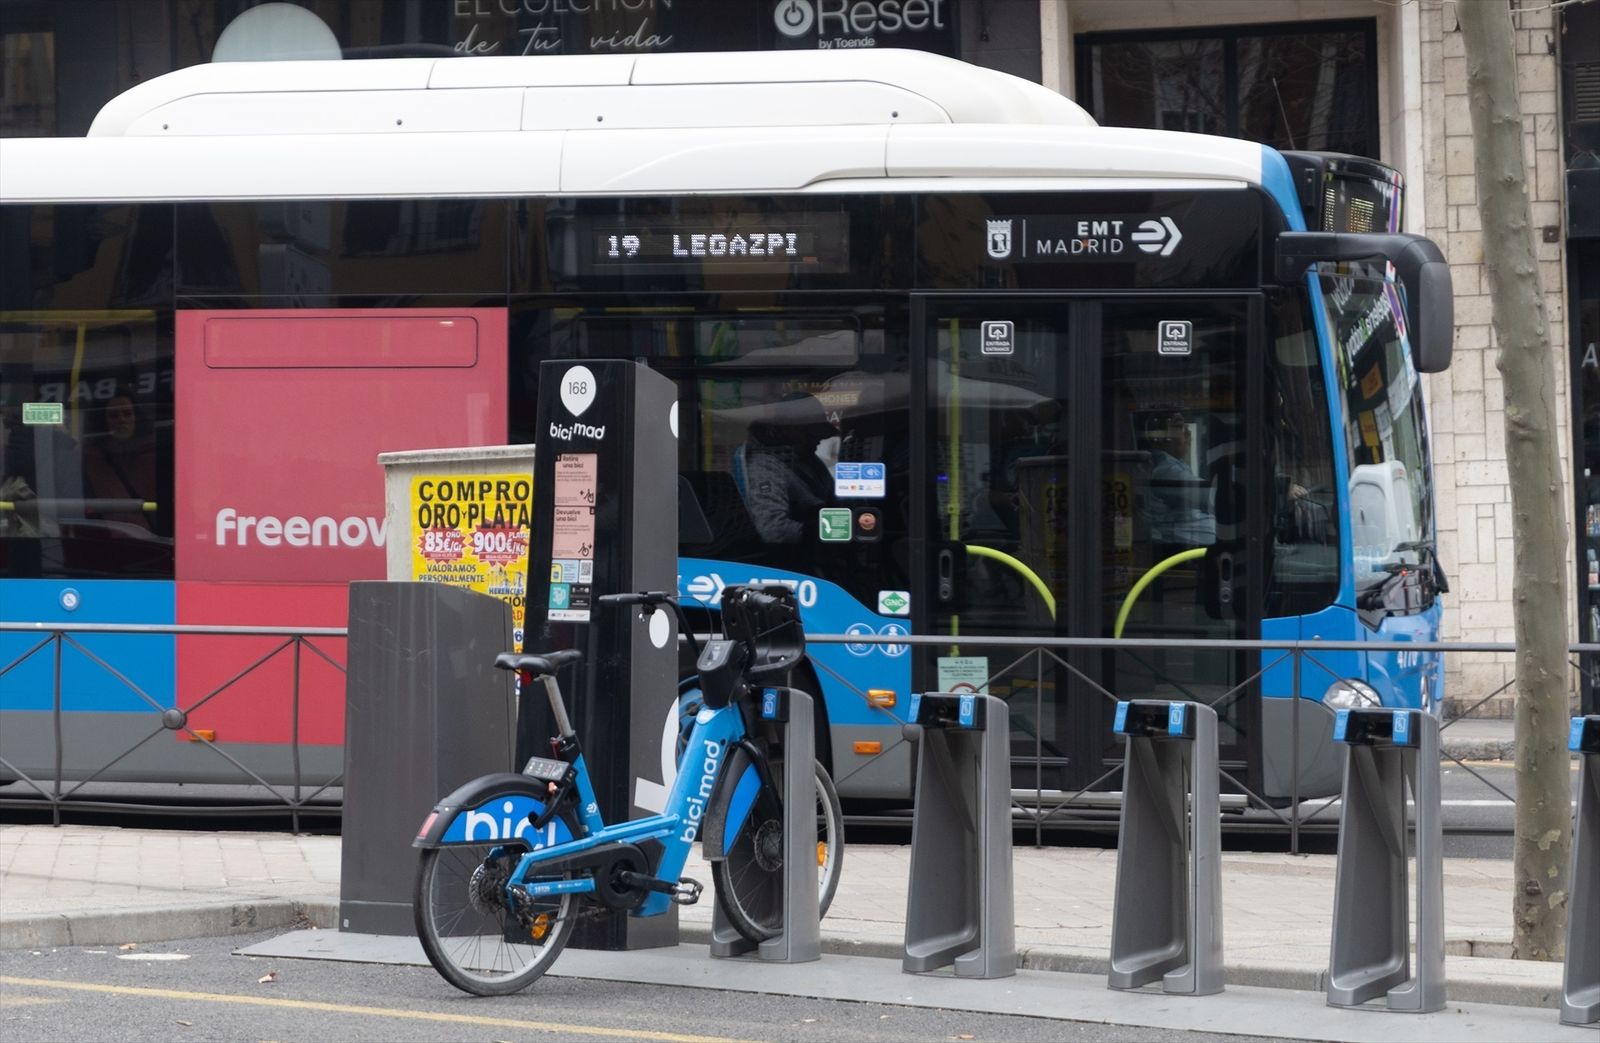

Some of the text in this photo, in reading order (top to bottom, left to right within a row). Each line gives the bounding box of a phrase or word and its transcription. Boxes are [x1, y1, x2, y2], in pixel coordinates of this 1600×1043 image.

[817, 0, 945, 34] Reset
[454, 24, 499, 53] de
[590, 17, 673, 48] vida
[818, 37, 876, 49] by Toende
[1077, 221, 1124, 236] EMT
[608, 233, 797, 256] 19 LEGAZPI
[1037, 238, 1124, 254] MADRID
[568, 382, 587, 395] 168
[418, 481, 530, 502] COMPRO
[418, 503, 531, 529] ORO Y PLATA
[427, 564, 477, 573] VALORAMOS
[419, 574, 485, 583] PERSONALMENTE
